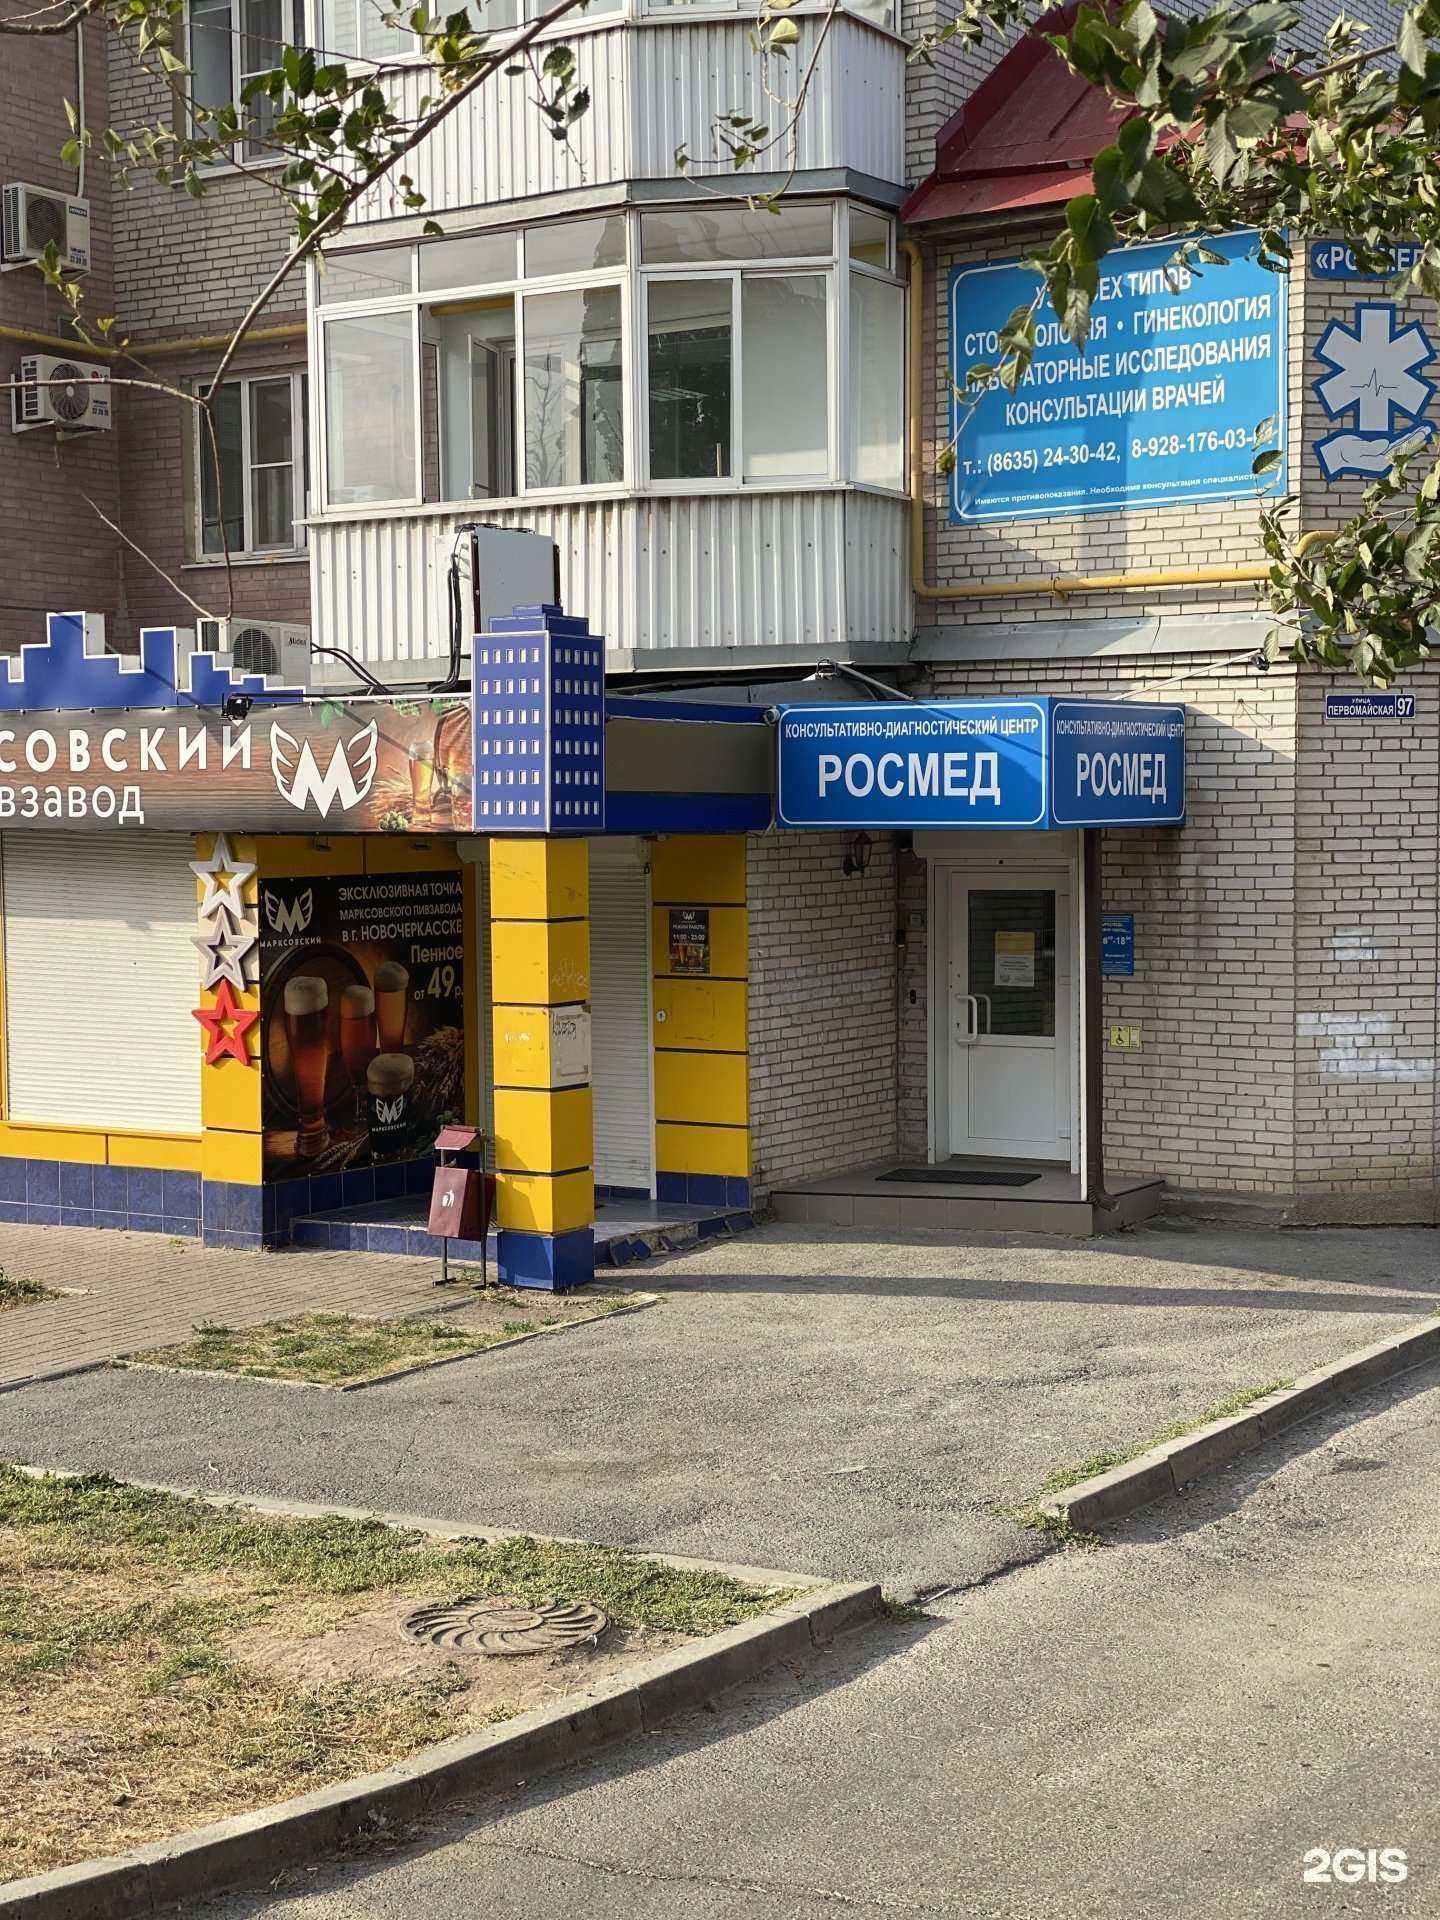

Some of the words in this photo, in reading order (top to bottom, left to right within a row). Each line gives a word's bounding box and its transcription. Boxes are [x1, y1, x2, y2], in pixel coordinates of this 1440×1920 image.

[1133, 294, 1271, 335] ГИНЕКОЛОГИЯ
[1115, 334, 1271, 376] ИССЛЕДОВАНИЯ
[1005, 388, 1147, 426] КОНСУЛЬТАЦИИ
[1152, 374, 1225, 411] ВРАЧЕЙ
[963, 460, 982, 475] т.:
[987, 449, 1038, 477] (8635)
[1043, 441, 1121, 468] 24-30-42,
[1327, 703, 1394, 716] ПЕРВОМАЙСКАЯ
[1397, 697, 1413, 716] 97
[785, 716, 998, 739] КОНСУЛЬТАТИВНО-ДИАГНОСТИЧЕСКИЙ
[1000, 718, 1039, 737] ЦЕНТР
[1056, 719, 1167, 739] КОНСУЛЬТАТИВНО-ДИАГНОСТИЧЕСКИЙ
[1167, 722, 1184, 740] ЦЕНТР
[818, 752, 1001, 806] РОСМЕД
[1076, 752, 1167, 804] РОСМЕД
[338, 883, 429, 901] ЭКСКЛЮЗИВНАЯ
[430, 881, 463, 896] ТОЧКА
[339, 905, 412, 921] МАРКСОВСКОГО
[413, 903, 463, 915] ПИВЗАВОДА
[361, 919, 462, 941] НОВОЧЕРКАССКЕ
[260, 936, 321, 949] МАРКСОВСКИЙ
[410, 944, 464, 964] Пенное
[414, 989, 425, 1001] от
[427, 964, 455, 998] 49
